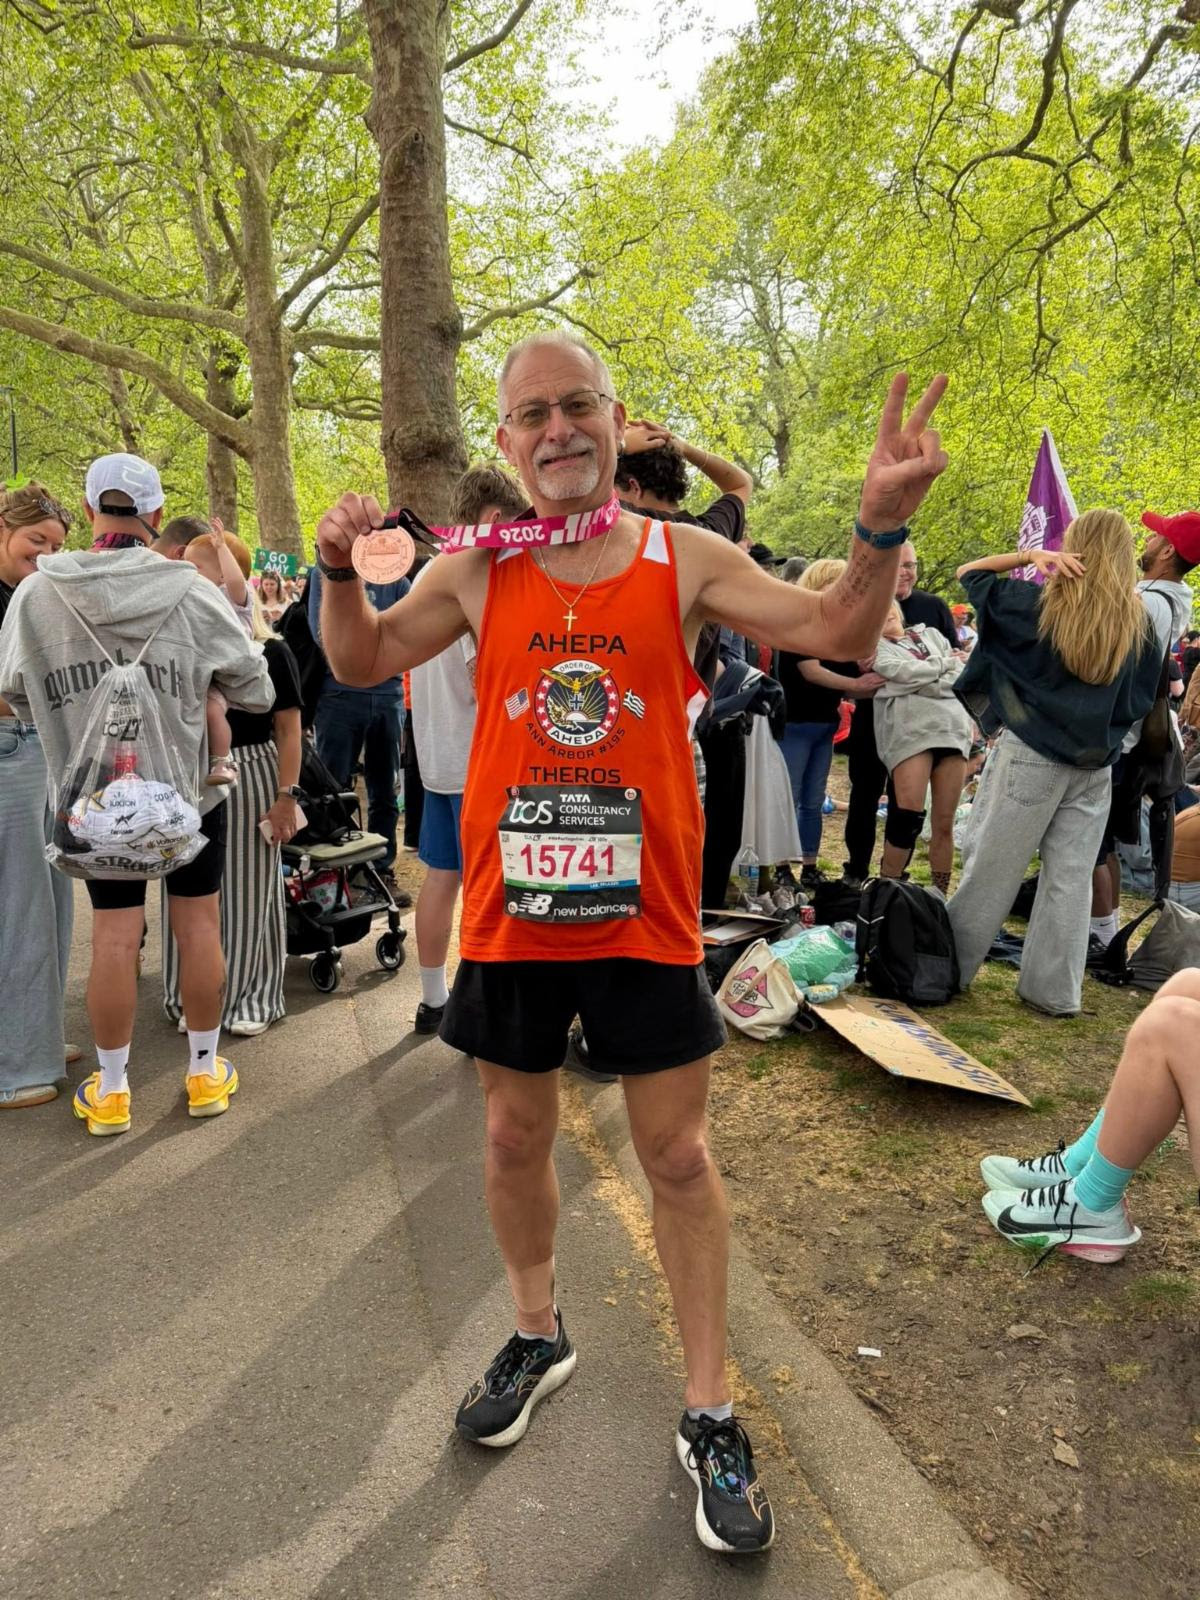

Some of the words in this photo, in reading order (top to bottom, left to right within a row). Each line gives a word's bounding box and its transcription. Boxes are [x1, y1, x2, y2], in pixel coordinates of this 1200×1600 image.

[499, 524, 545, 543] 2026
[269, 551, 288, 564] GO
[264, 562, 290, 574] AMY
[528, 632, 627, 655] AHEPA
[560, 662, 583, 672] ORDER
[584, 663, 594, 671] OF
[527, 722, 546, 747] ANN
[547, 746, 595, 760] ARBOR
[600, 727, 626, 753] #195
[551, 731, 604, 745] AHEPA
[529, 766, 621, 784] THEROS
[560, 794, 591, 803] TATA
[559, 805, 631, 816] CONSULTANCY
[559, 816, 605, 825] SERVICES
[520, 844, 614, 877] 15741
[553, 907, 577, 917] new
[580, 903, 628, 916] balance
